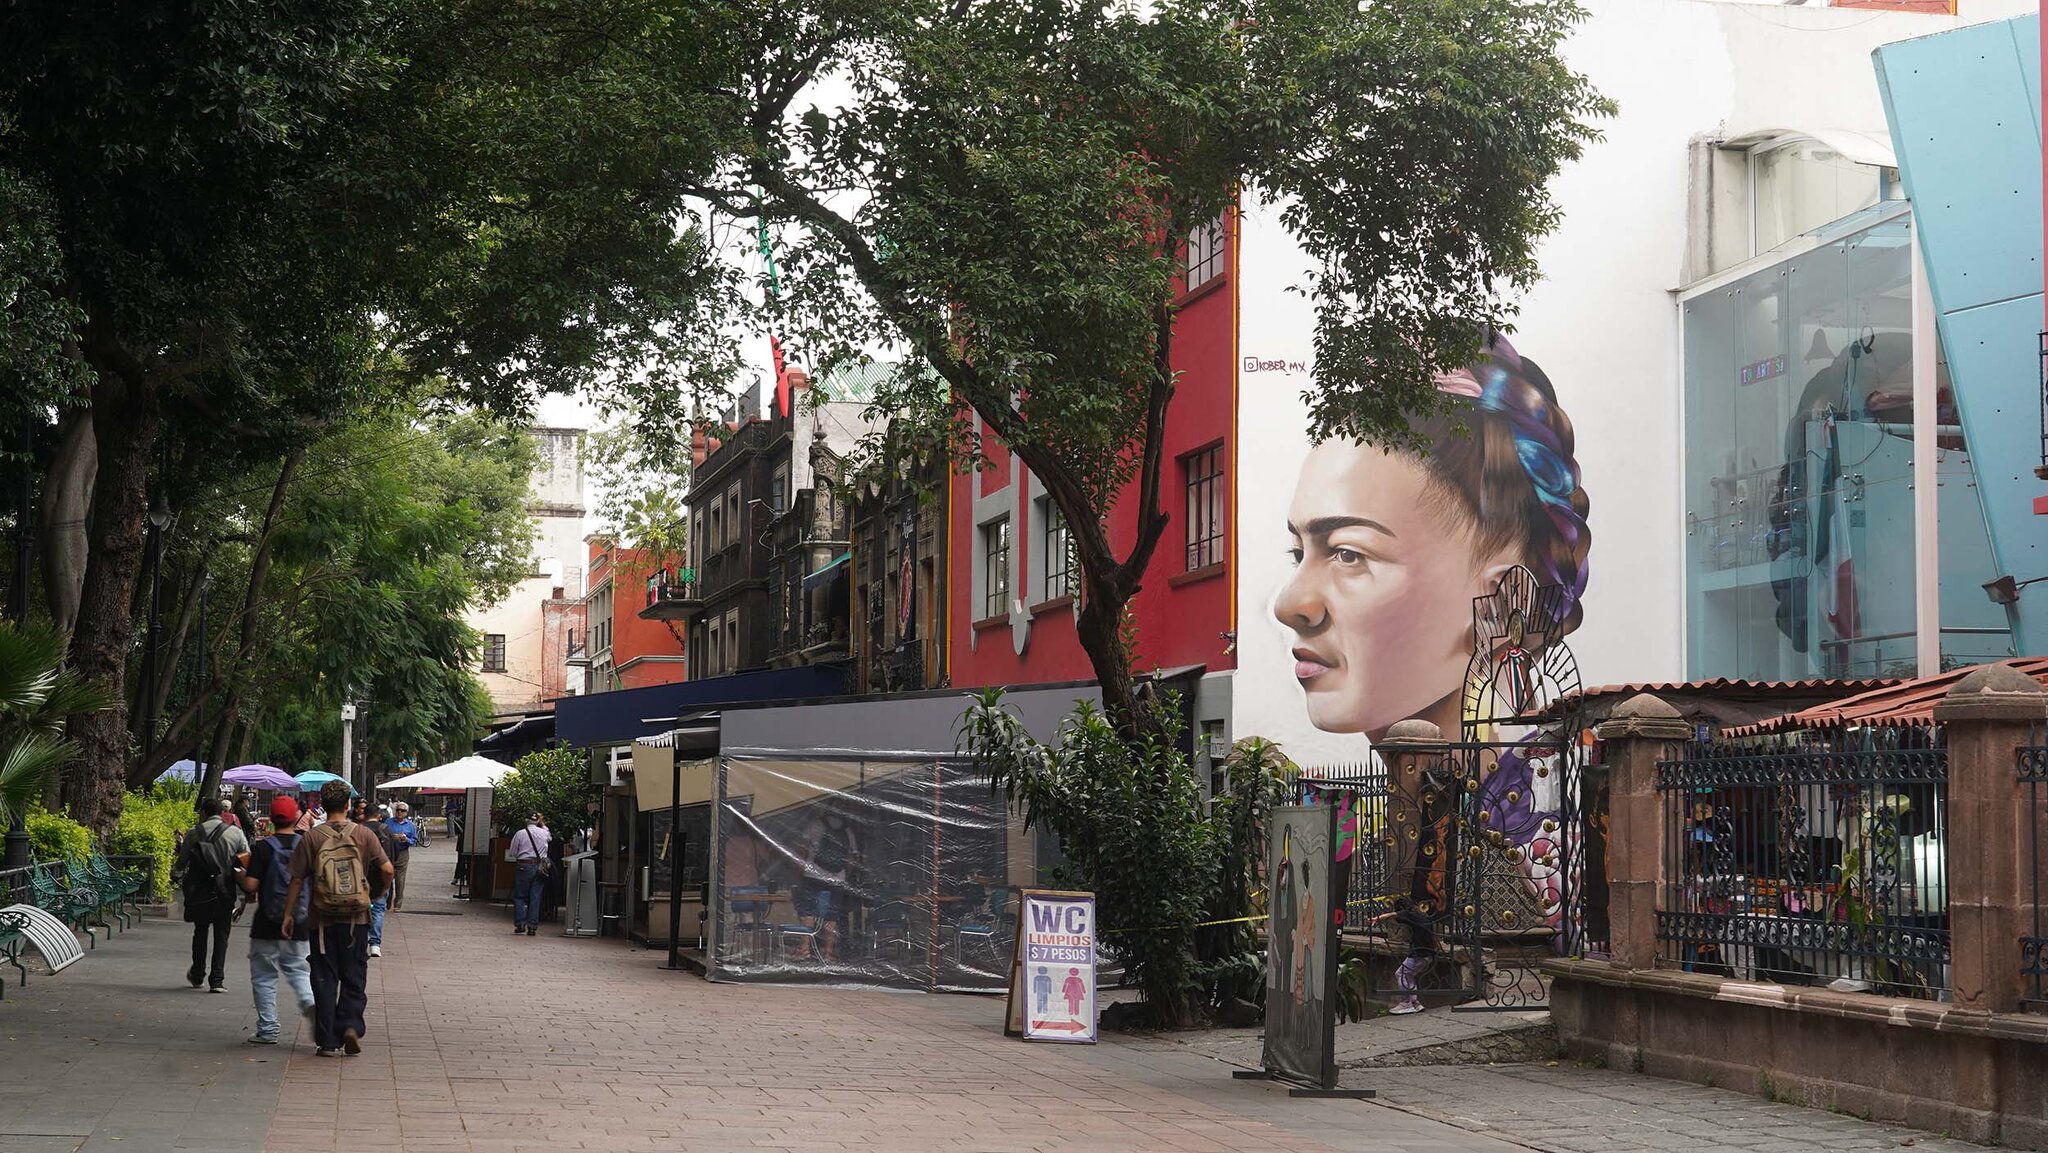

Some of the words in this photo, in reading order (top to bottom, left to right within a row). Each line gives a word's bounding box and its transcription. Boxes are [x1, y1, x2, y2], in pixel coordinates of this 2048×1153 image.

[1032, 904, 1085, 934] WC
[1029, 934, 1090, 946] LIMPIOS
[1031, 947, 1038, 959] $
[1042, 948, 1048, 959] 7
[1052, 948, 1086, 961] PESOS
